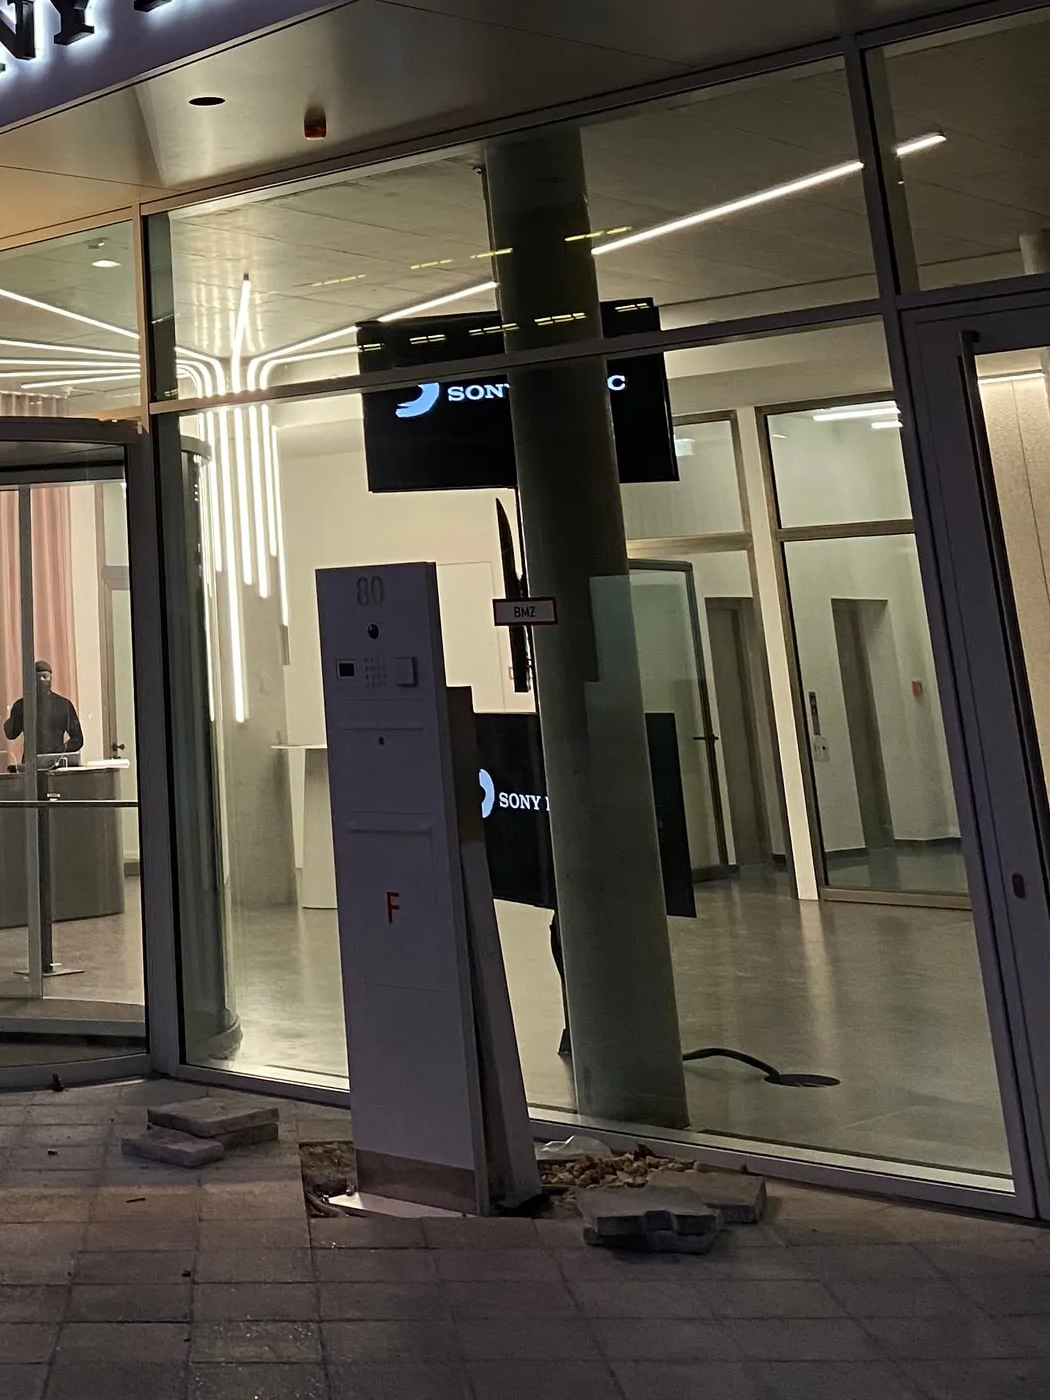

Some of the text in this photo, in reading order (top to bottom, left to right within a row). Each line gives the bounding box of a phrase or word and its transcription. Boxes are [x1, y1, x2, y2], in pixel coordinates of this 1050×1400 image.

[447, 384, 510, 402] SON
[356, 576, 384, 606] 80
[514, 606, 536, 618] BMZ
[499, 792, 542, 811] SONY
[386, 891, 400, 924] F
